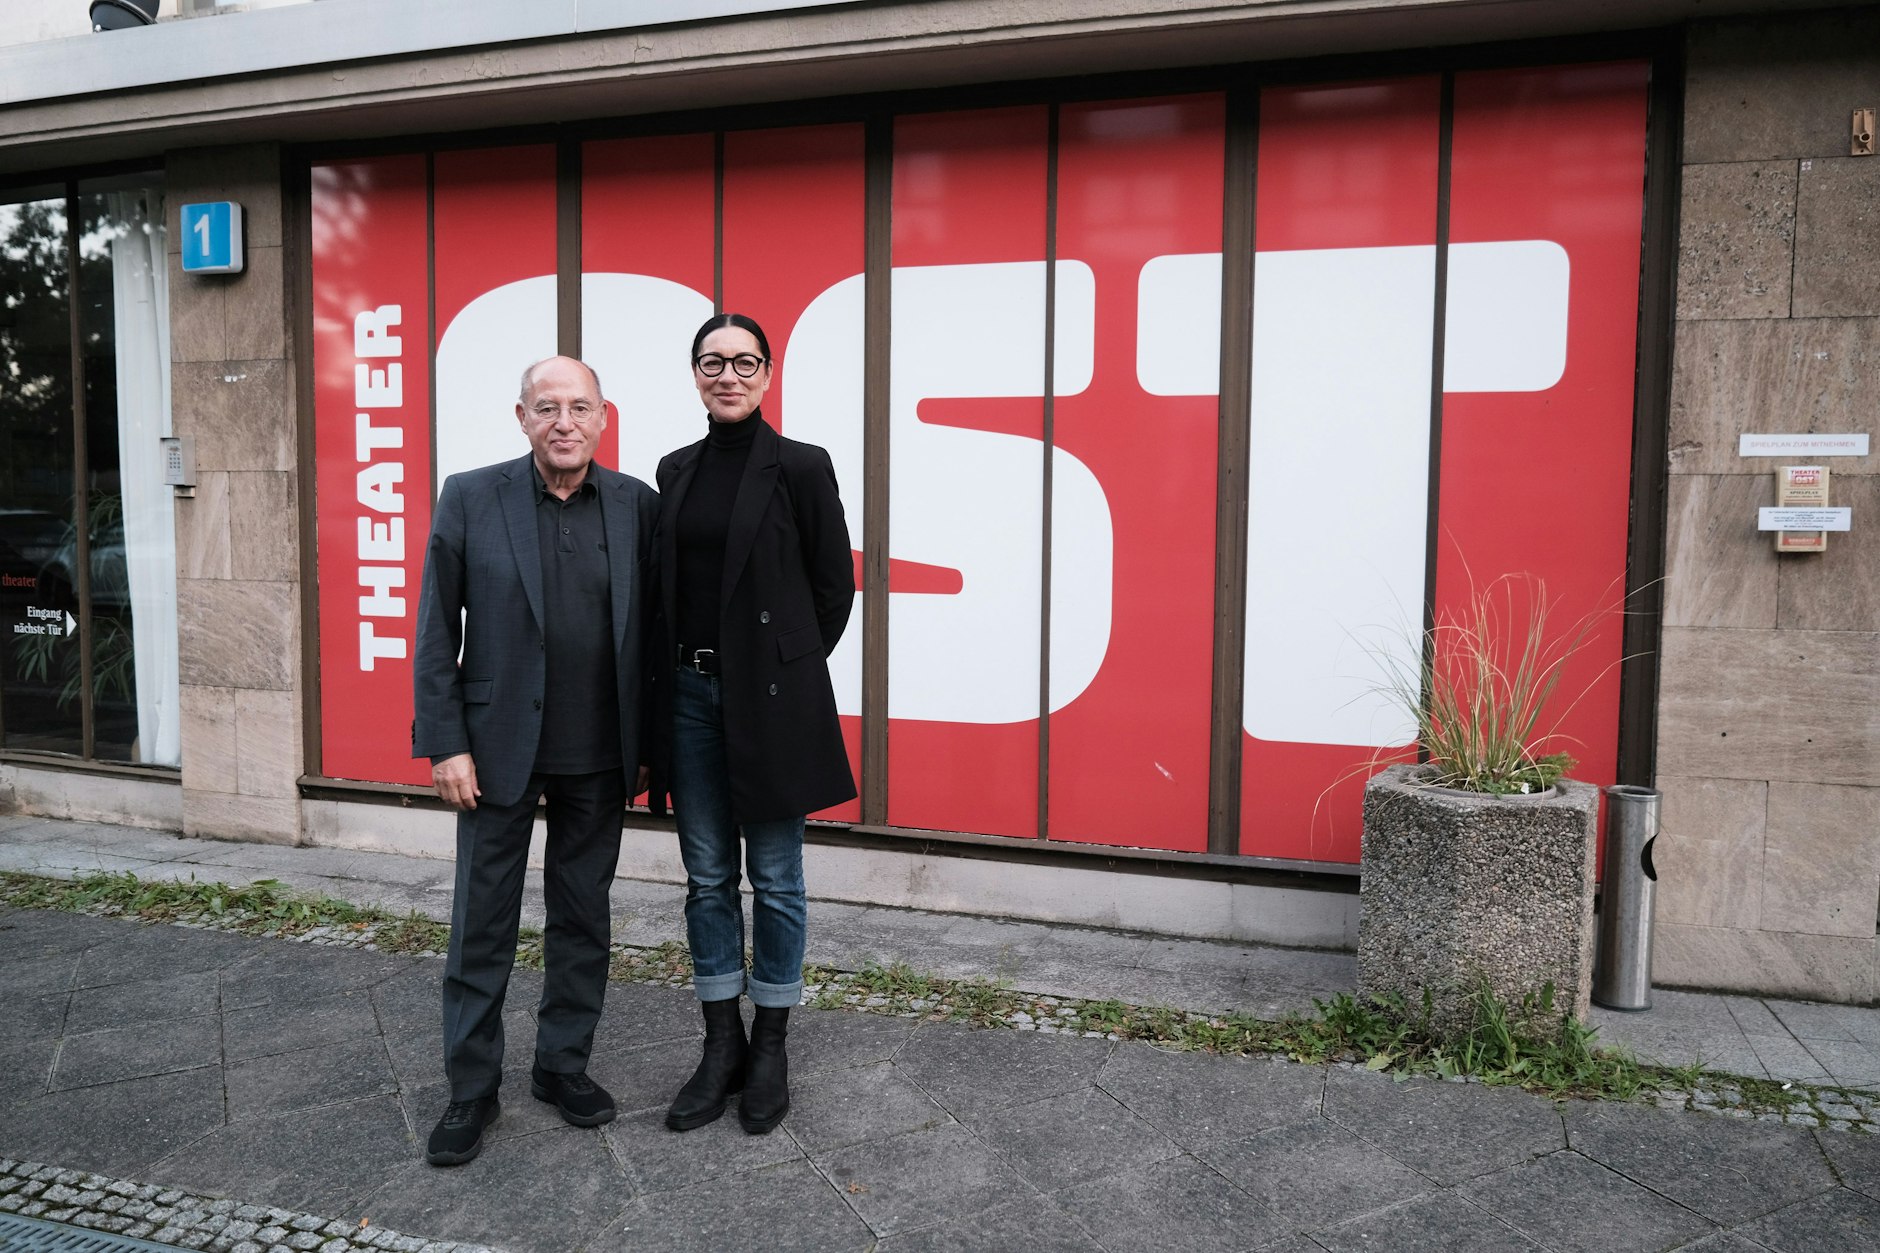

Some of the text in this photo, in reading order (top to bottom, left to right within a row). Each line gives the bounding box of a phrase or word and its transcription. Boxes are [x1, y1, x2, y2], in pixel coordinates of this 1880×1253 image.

[193, 213, 211, 257] 1
[1750, 441, 1791, 449] SPIELPLAN
[1811, 440, 1856, 448] MITNEHMEN
[354, 304, 407, 672] THEATER
[2, 573, 36, 587] theater
[27, 605, 62, 621] Eingang
[14, 622, 63, 636] nächste Tür
